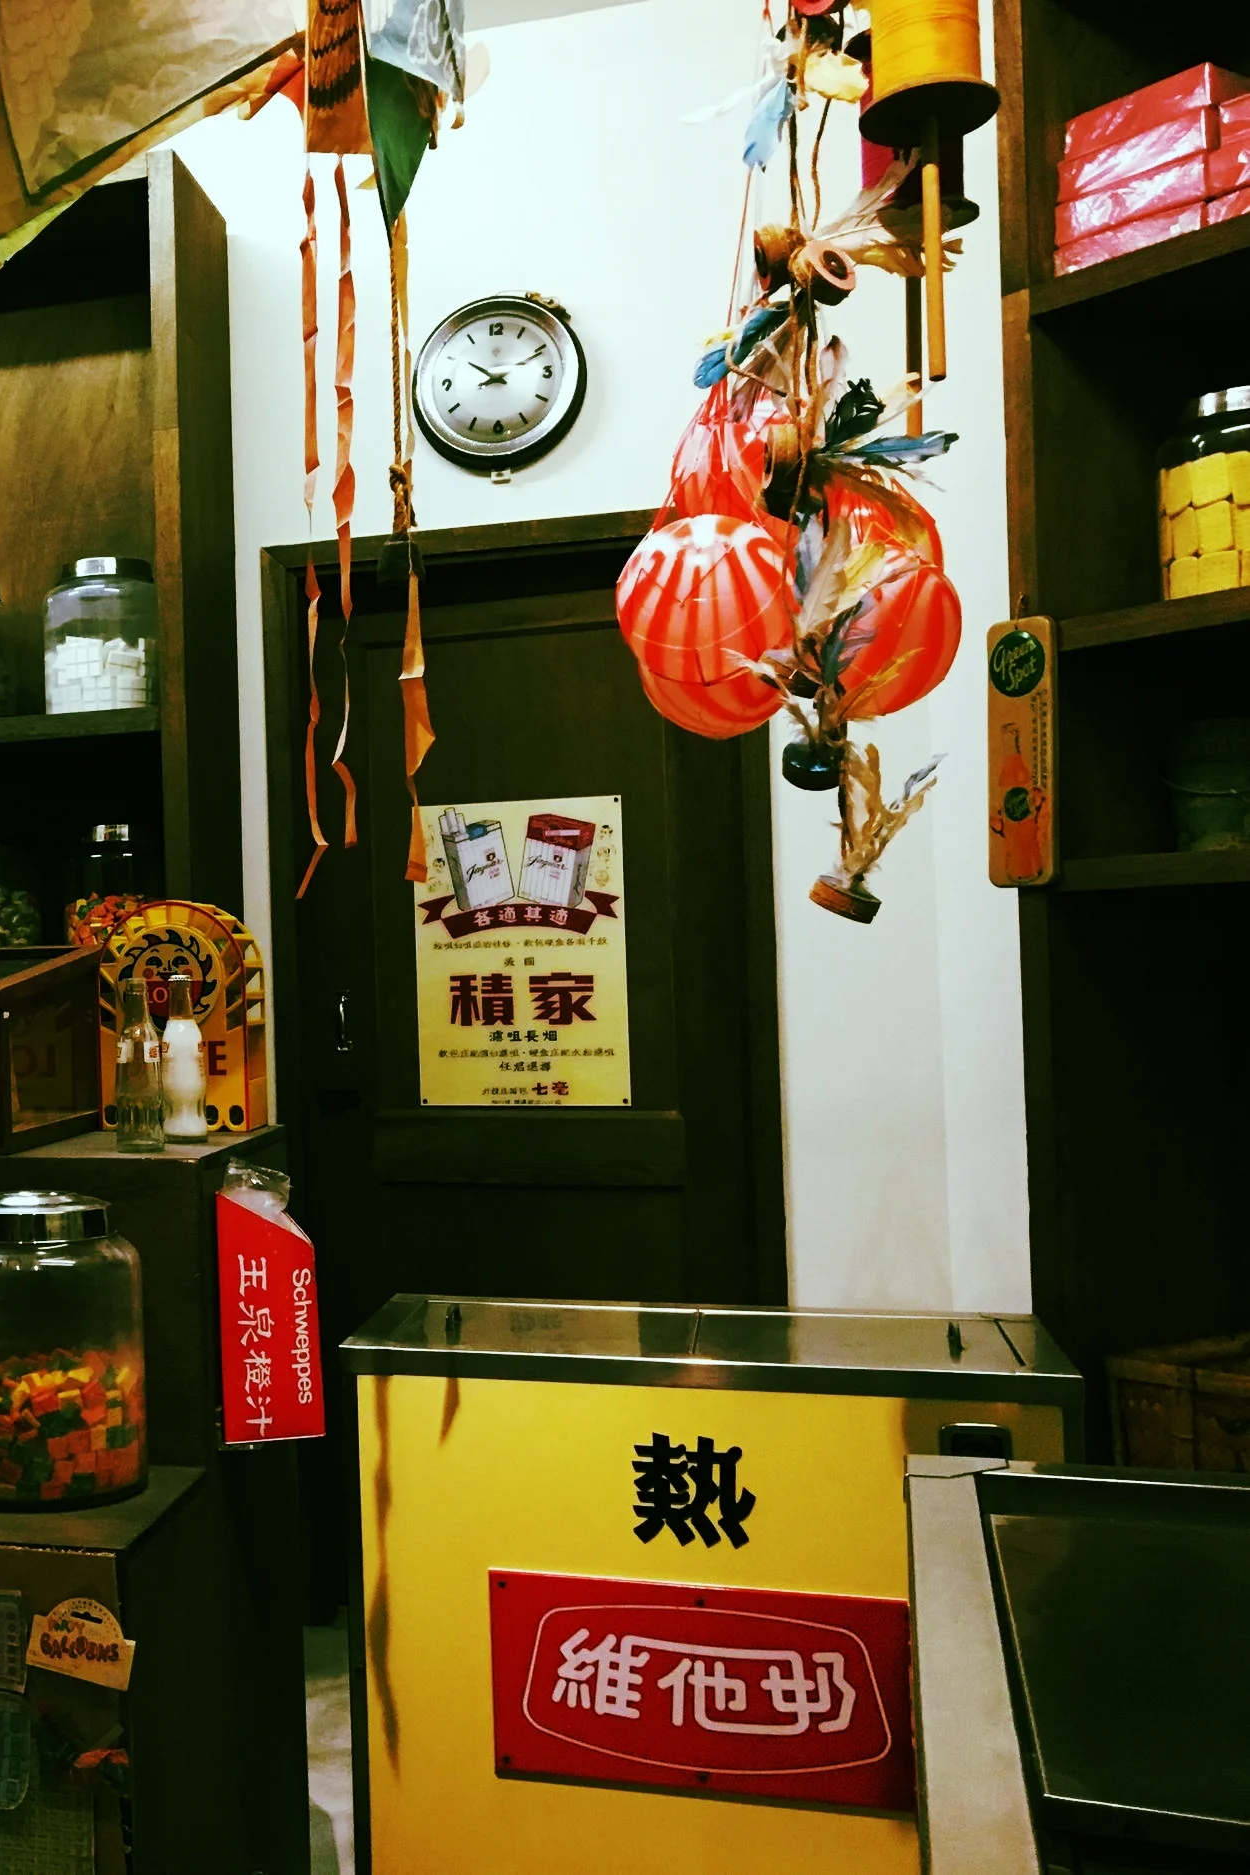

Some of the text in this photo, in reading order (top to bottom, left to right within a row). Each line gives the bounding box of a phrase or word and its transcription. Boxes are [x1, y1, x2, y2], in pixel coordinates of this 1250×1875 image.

[488, 322, 504, 336] 12
[441, 379, 452, 391] 9
[542, 366, 553, 379] 3
[493, 419, 504, 434] 6
[993, 640, 1037, 681] Green
[1005, 655, 1038, 691] Spot
[449, 971, 597, 1026] 積家
[237, 1253, 275, 1437] 玉泉橙汁
[291, 1268, 313, 1405] Schweppes
[631, 1431, 756, 1549] 熱
[551, 1627, 857, 1736] 維他奶
